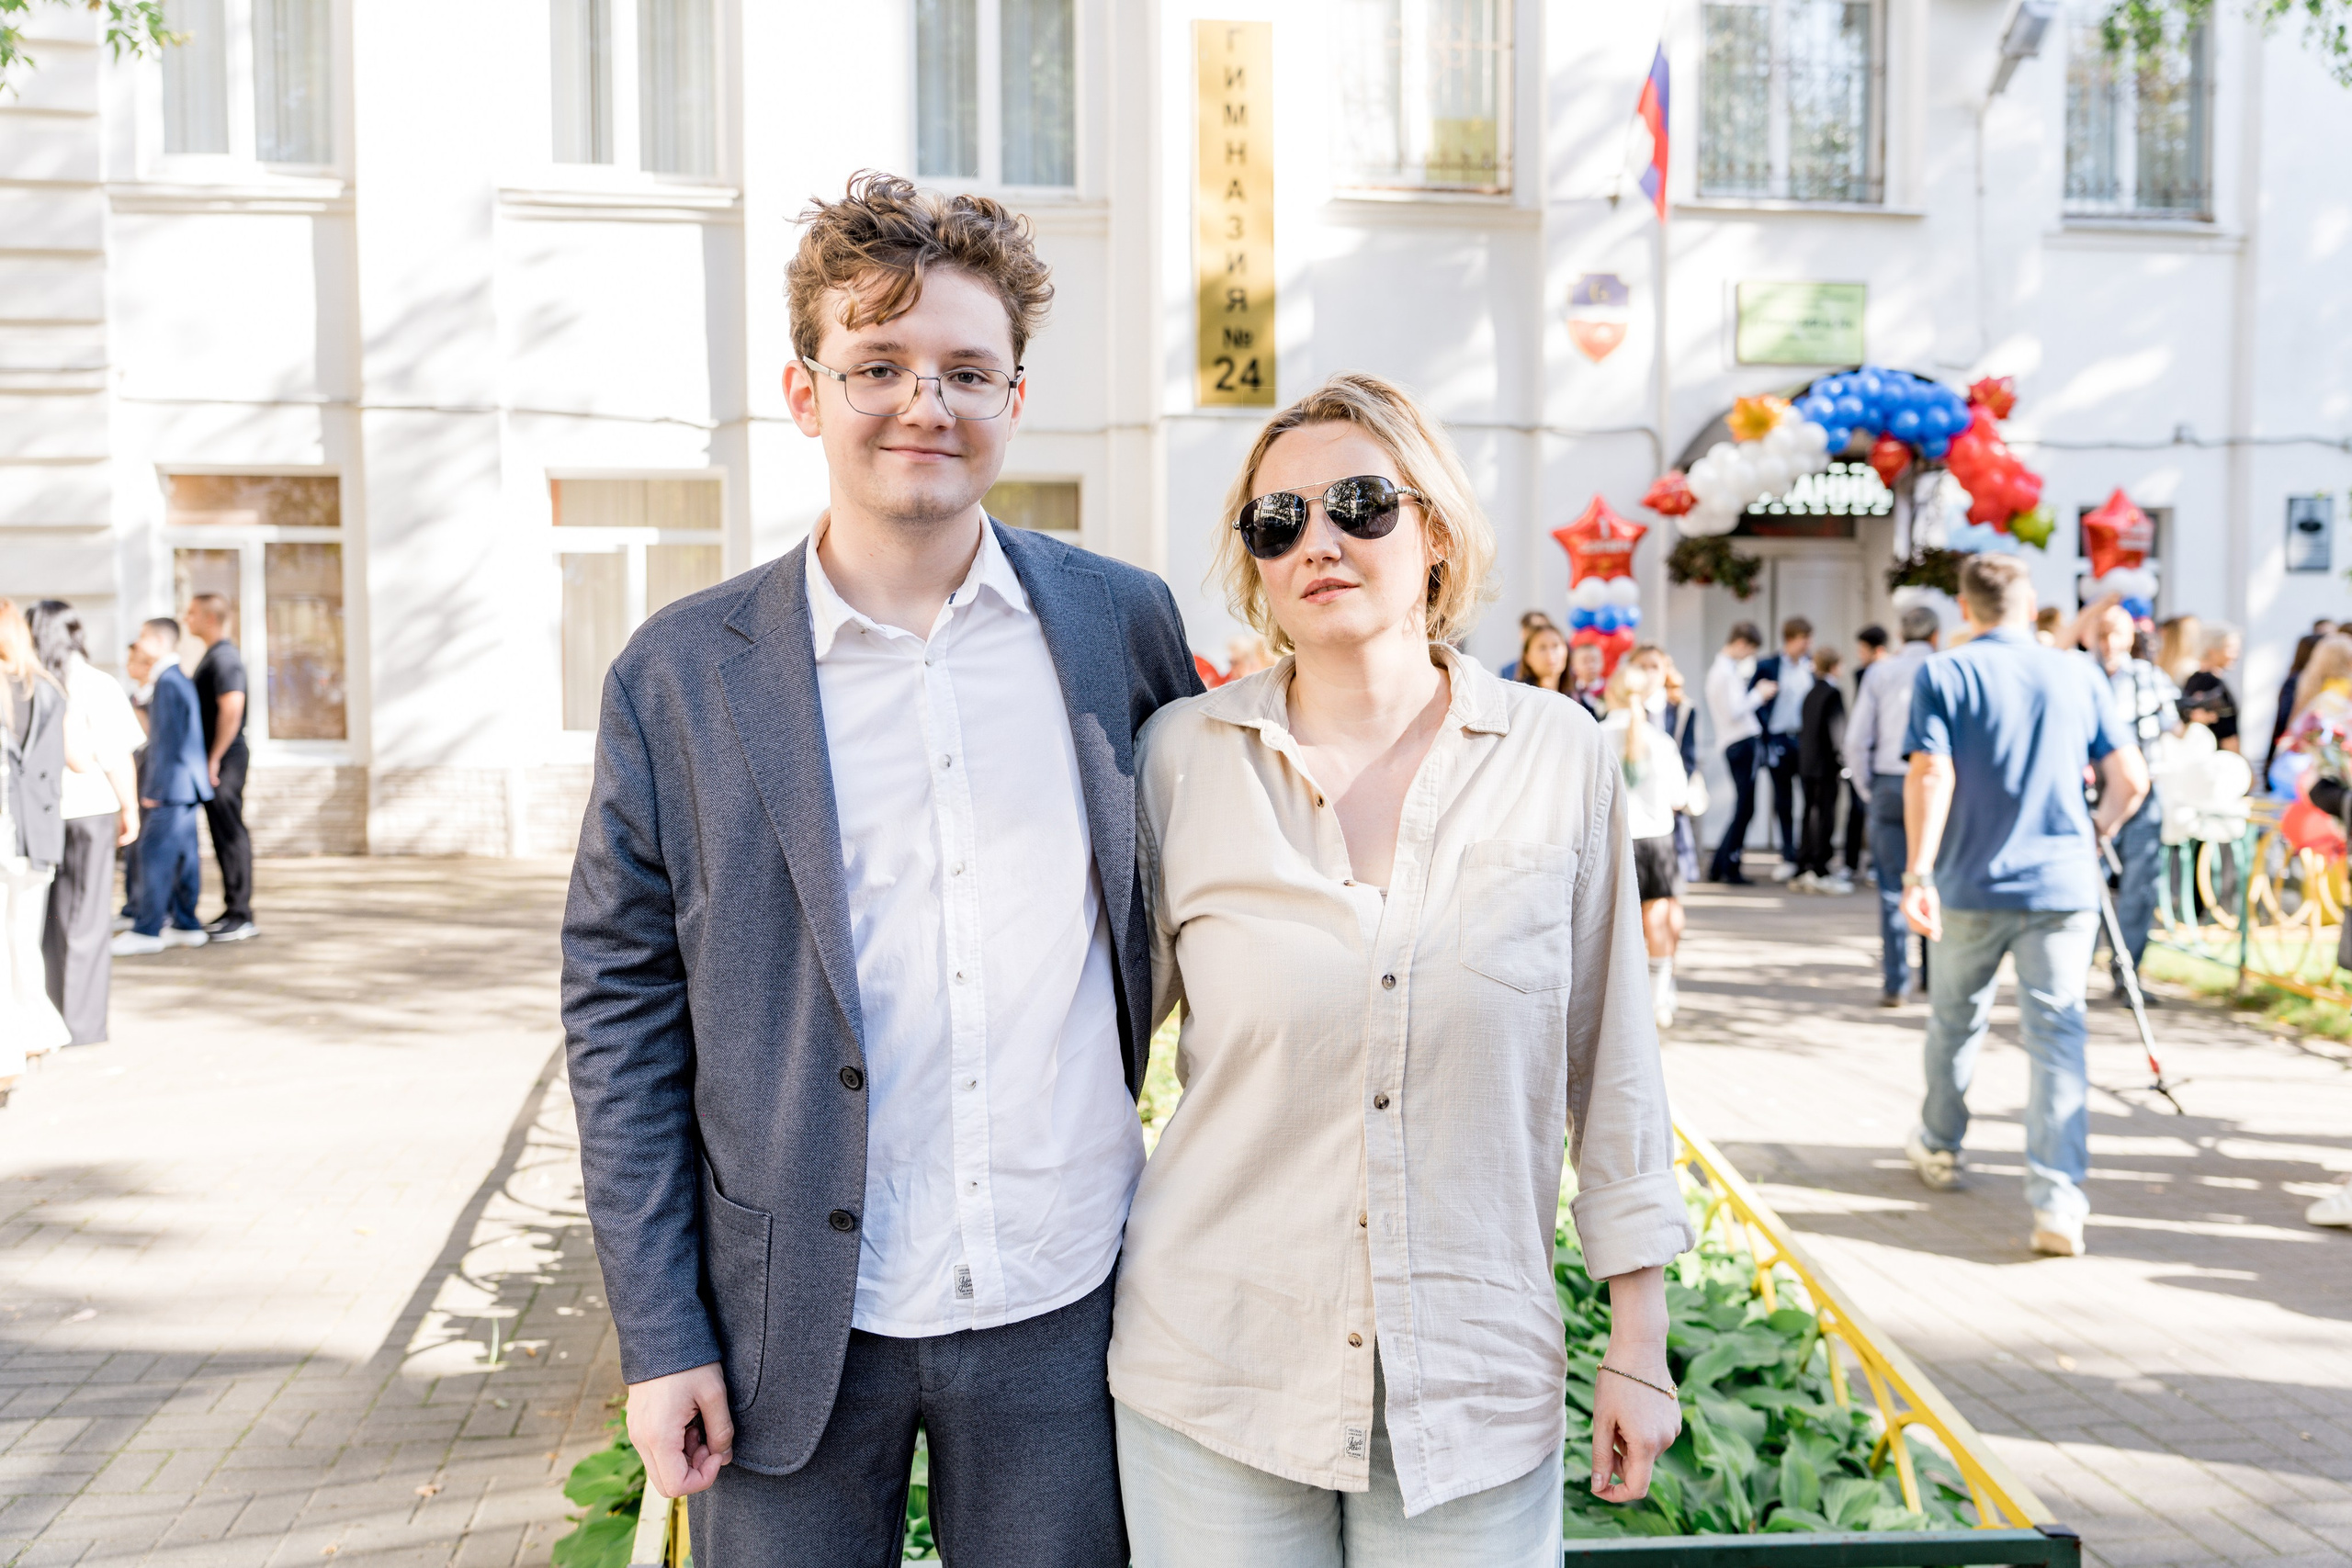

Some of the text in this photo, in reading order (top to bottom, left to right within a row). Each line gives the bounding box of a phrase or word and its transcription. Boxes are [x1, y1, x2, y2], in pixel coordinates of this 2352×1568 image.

[1224, 28, 1248, 313] ГИМНАЗИЯ
[1223, 326, 1253, 349] №
[1214, 355, 1261, 394] 24
